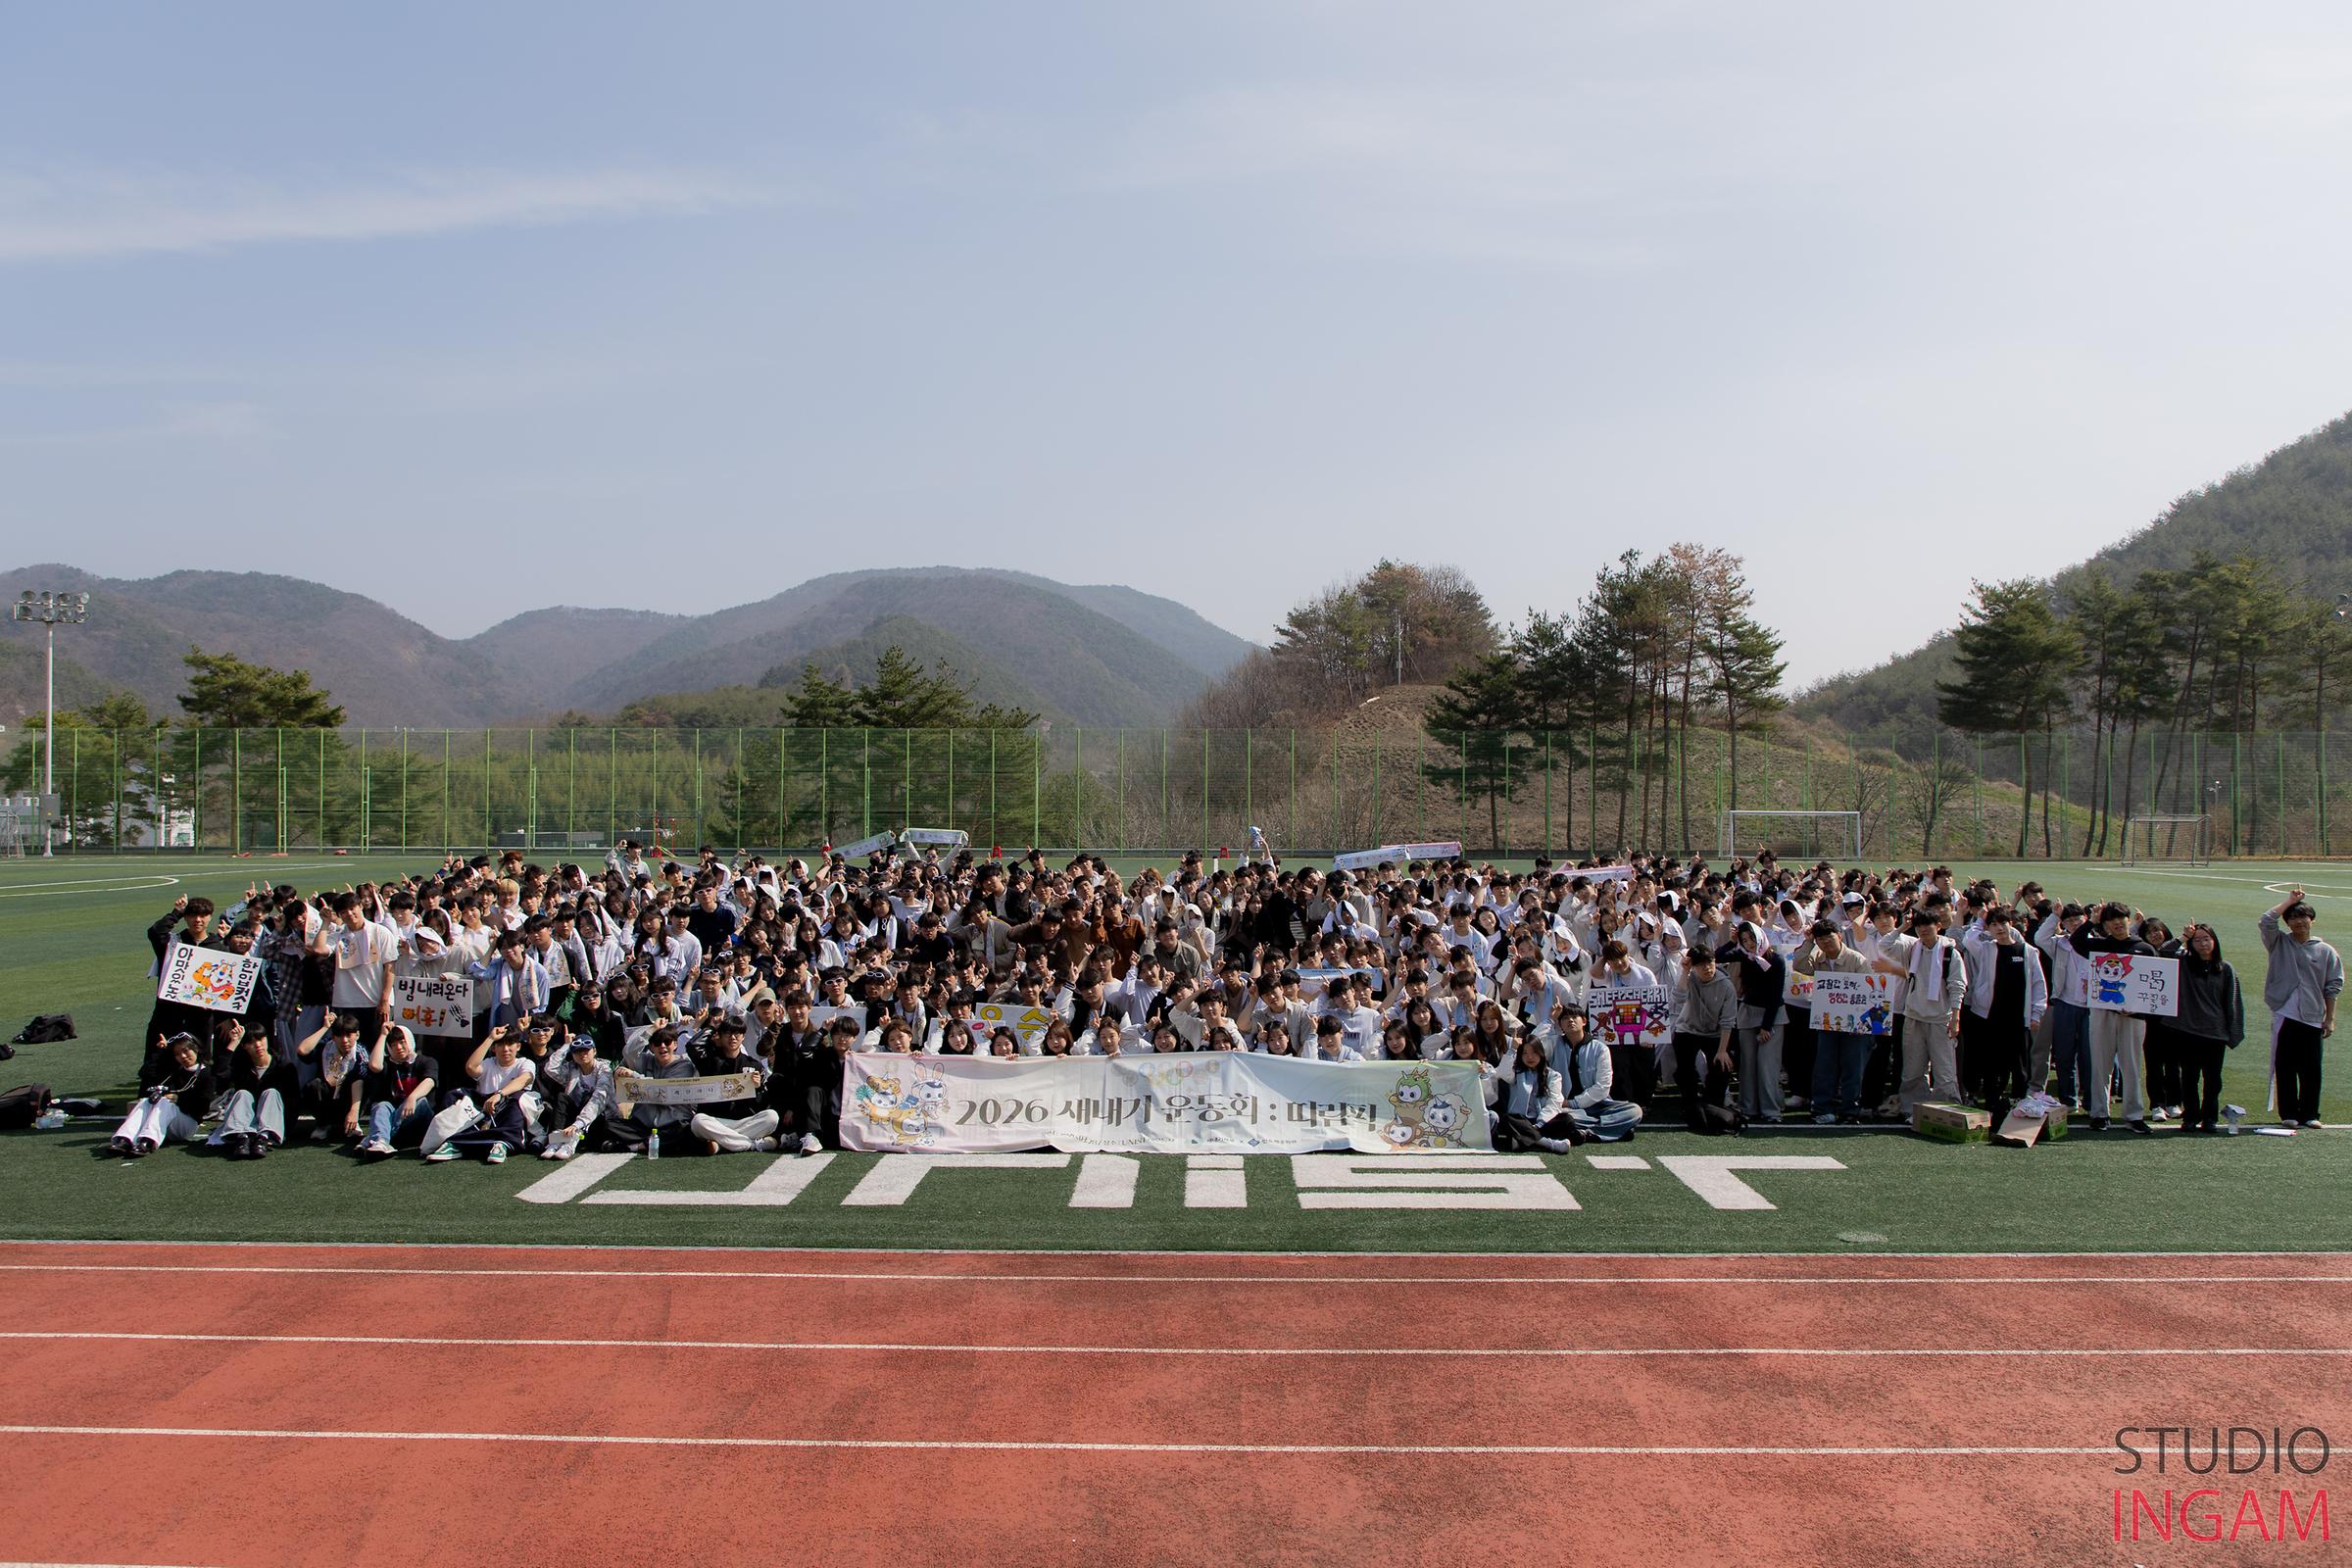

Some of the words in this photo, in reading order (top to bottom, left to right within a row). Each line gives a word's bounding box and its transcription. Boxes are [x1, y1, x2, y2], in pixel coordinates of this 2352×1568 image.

[956, 1098, 1049, 1126] 2026
[1056, 1095, 1152, 1127] 새내기
[1161, 1093, 1258, 1125] 운동회
